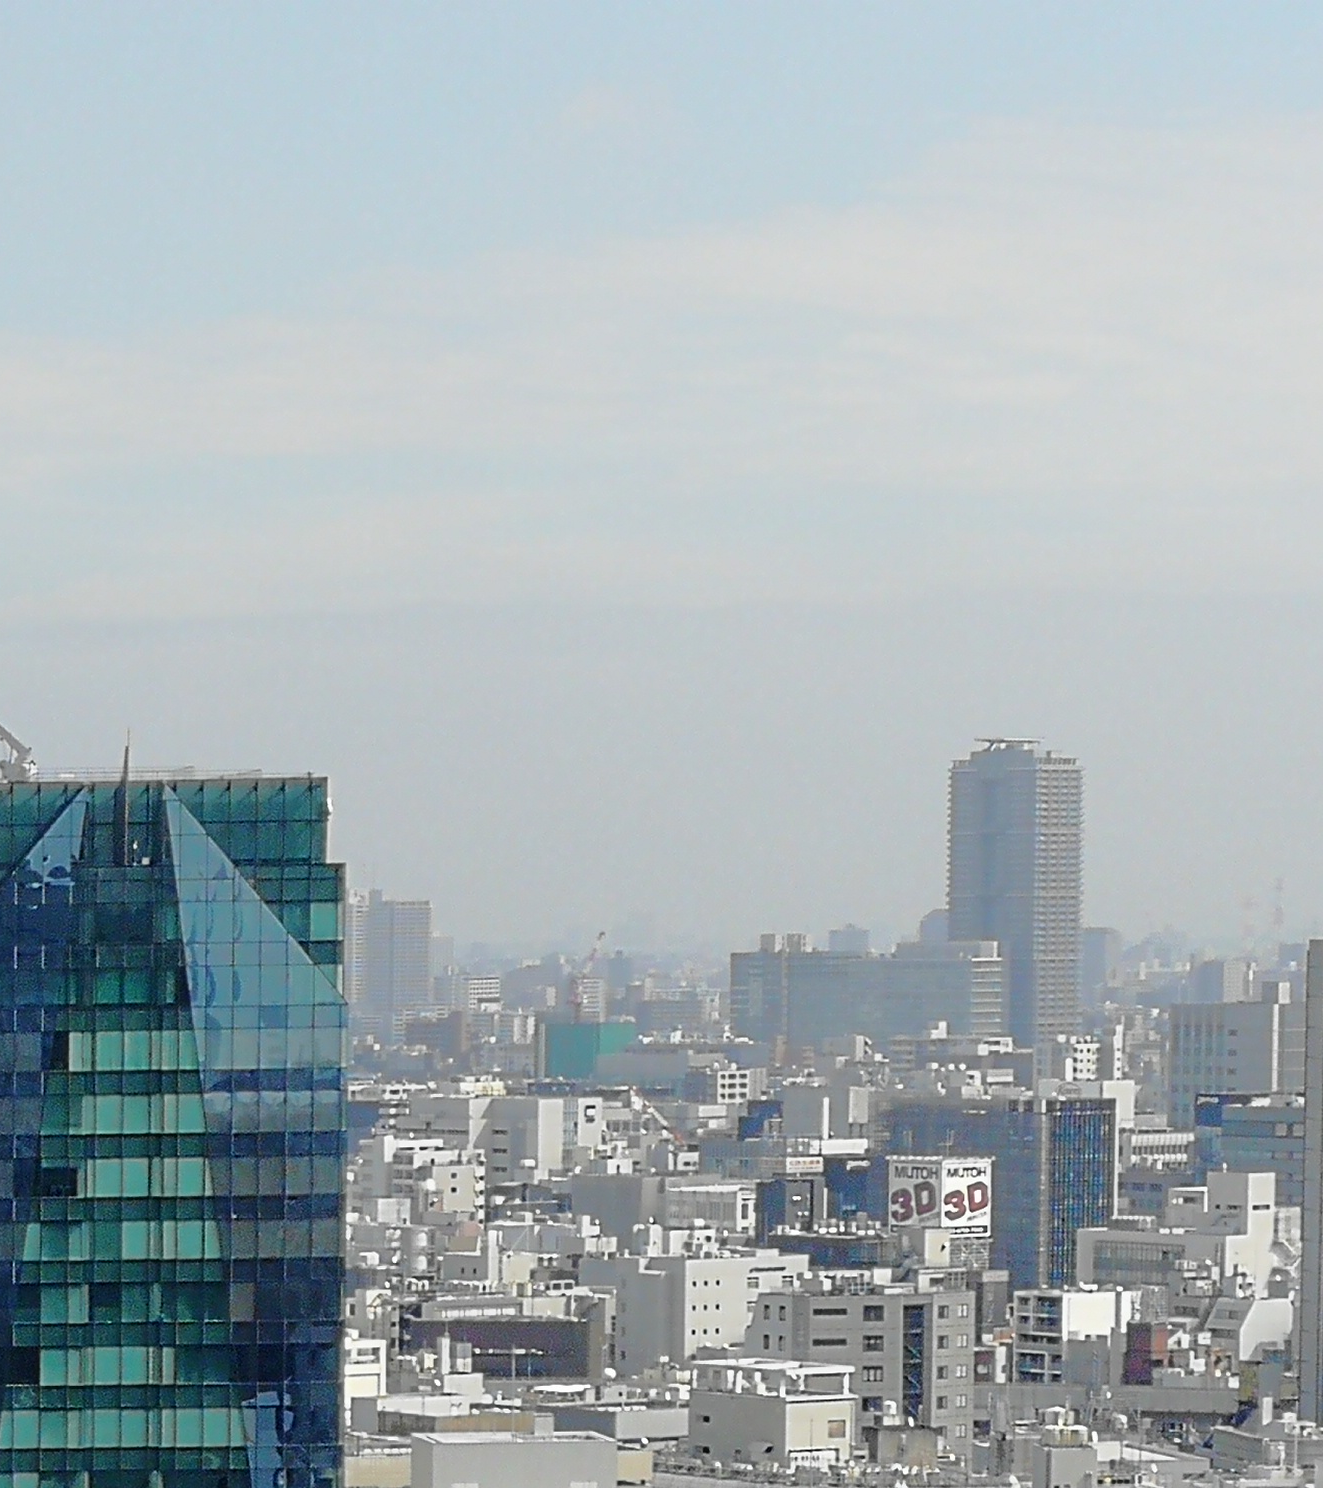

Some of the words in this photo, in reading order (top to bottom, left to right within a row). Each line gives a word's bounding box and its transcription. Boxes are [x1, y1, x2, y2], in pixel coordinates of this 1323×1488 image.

[894, 1166, 939, 1180] MUTOH
[946, 1166, 986, 1178] MUTOH
[890, 1180, 937, 1223] 3D
[943, 1181, 989, 1221] 3D
